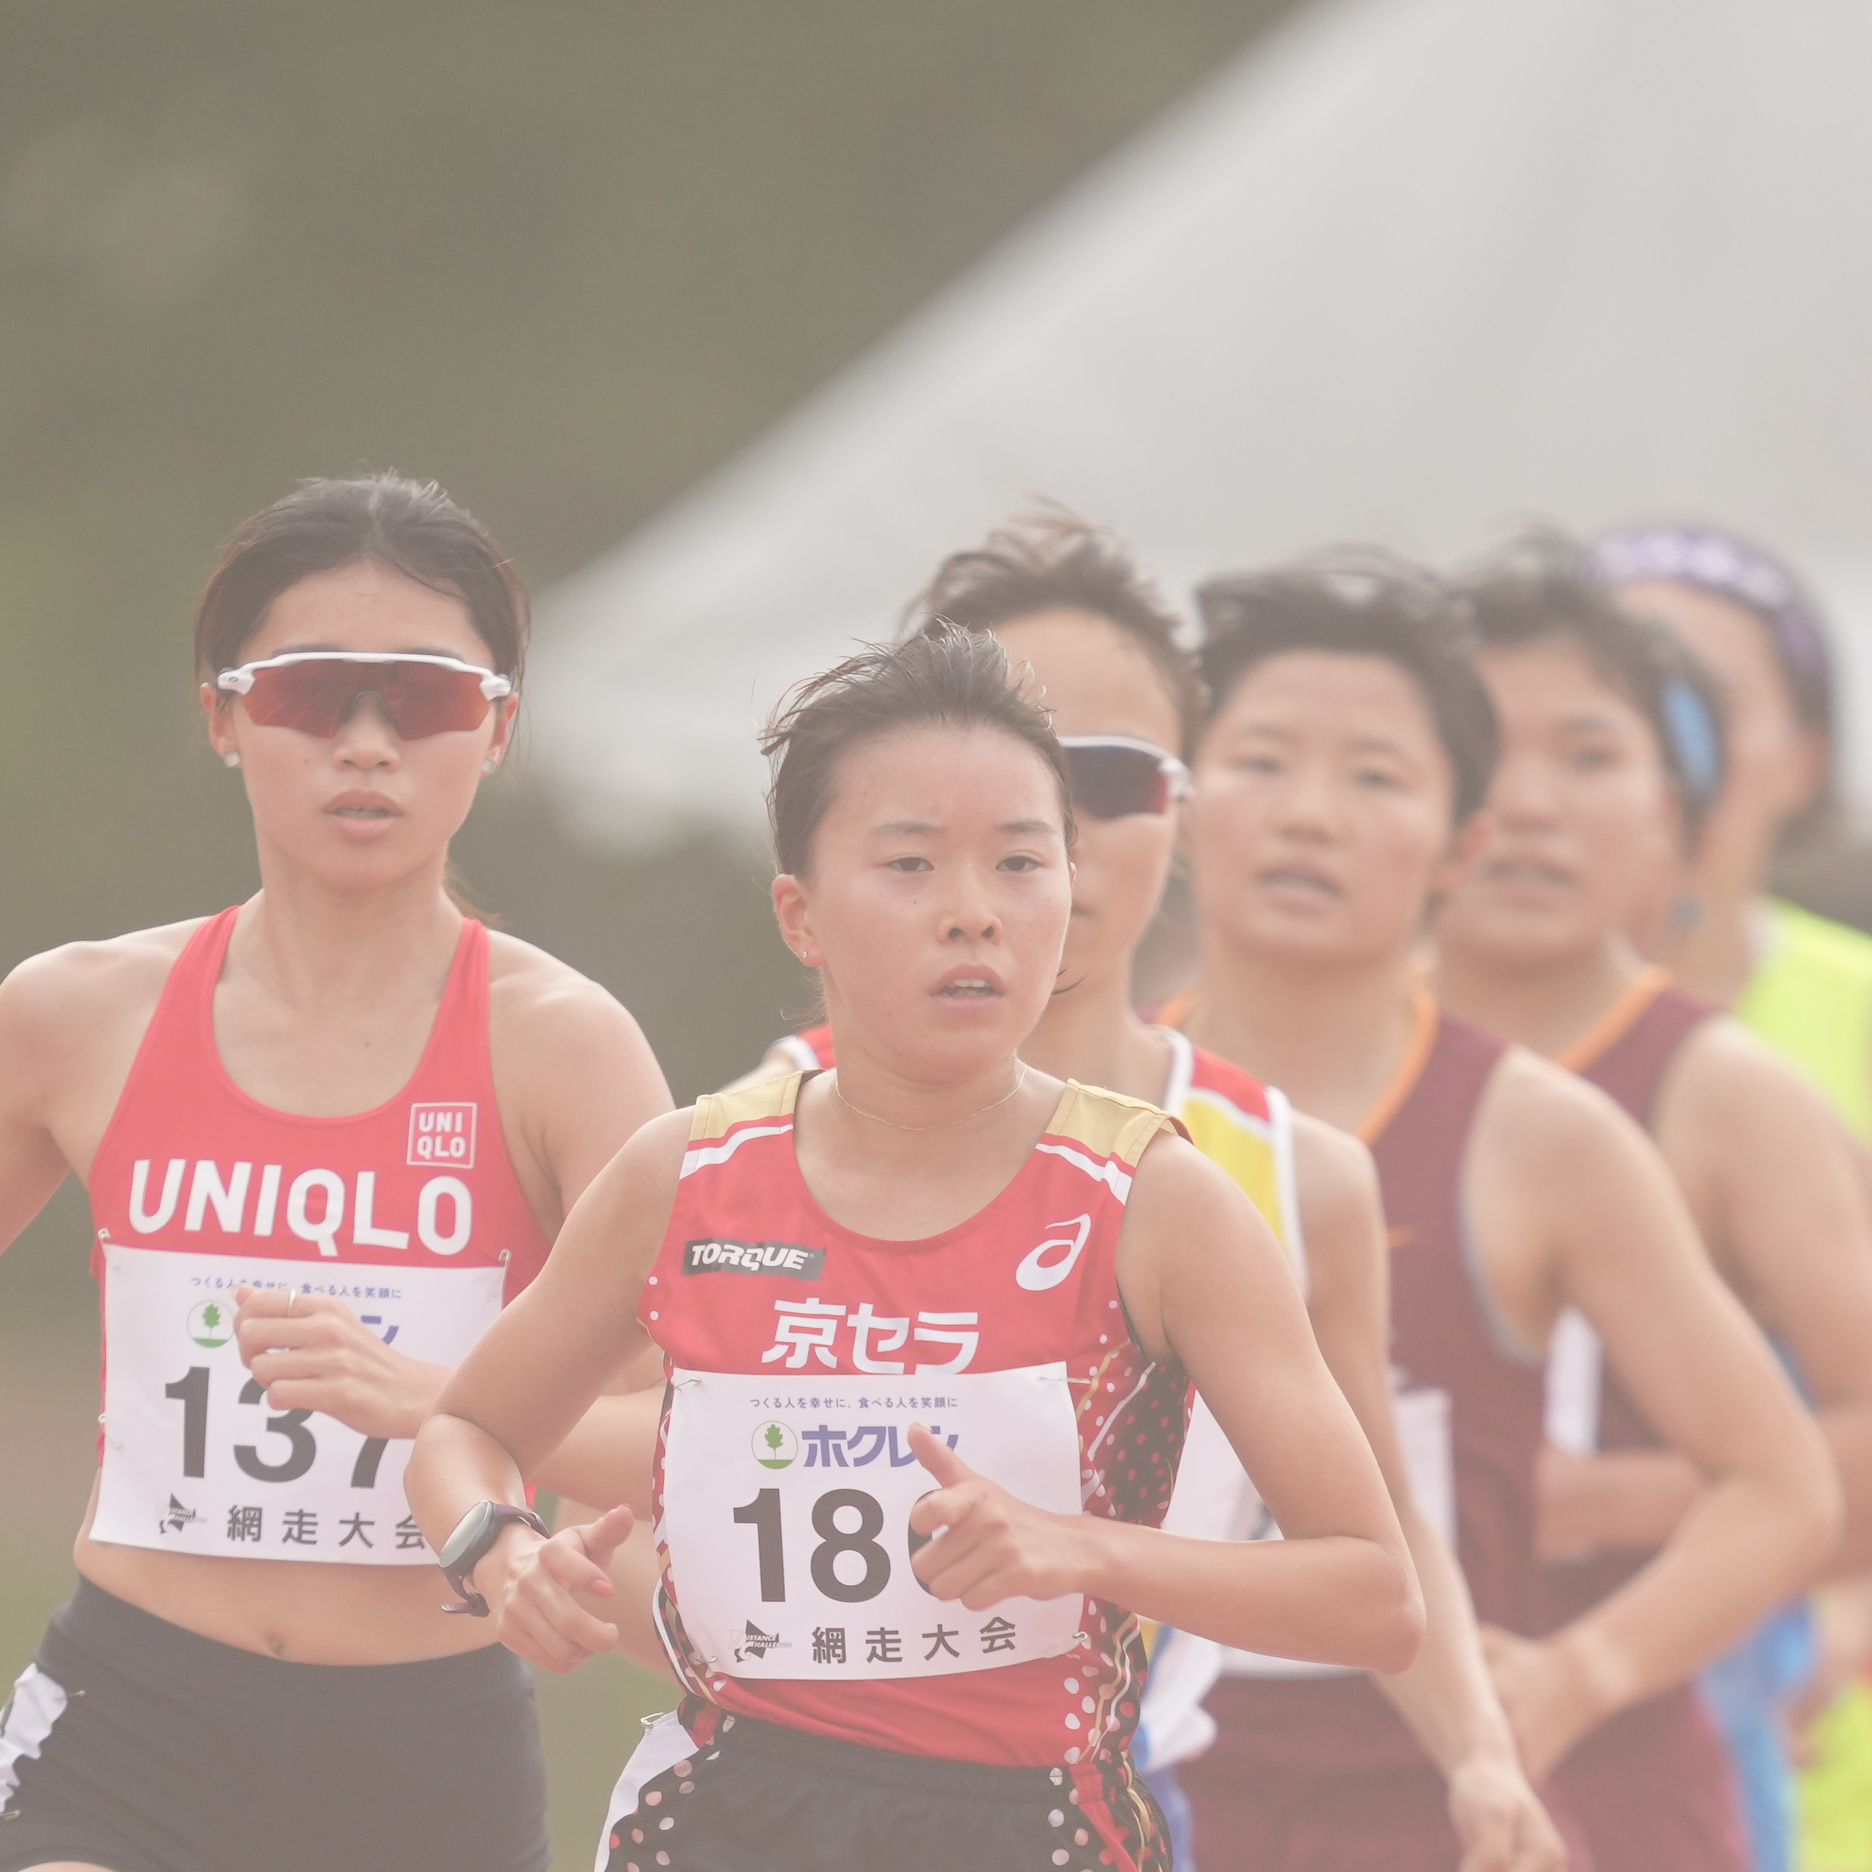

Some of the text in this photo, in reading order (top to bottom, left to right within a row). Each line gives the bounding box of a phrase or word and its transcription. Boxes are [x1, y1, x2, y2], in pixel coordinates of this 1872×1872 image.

[418, 1111, 463, 1133] UNI
[417, 1136, 466, 1160] QLO
[128, 1158, 473, 1257] UNIQLO
[691, 1243, 809, 1272] TORQUE
[761, 1297, 980, 1375] 京セラ
[749, 1395, 959, 1410] つくる人を幸せに、食べる人を笑顔に
[226, 1504, 427, 1551] 網走大会
[732, 1488, 940, 1604] 18
[811, 1615, 1017, 1665] 網走大会
